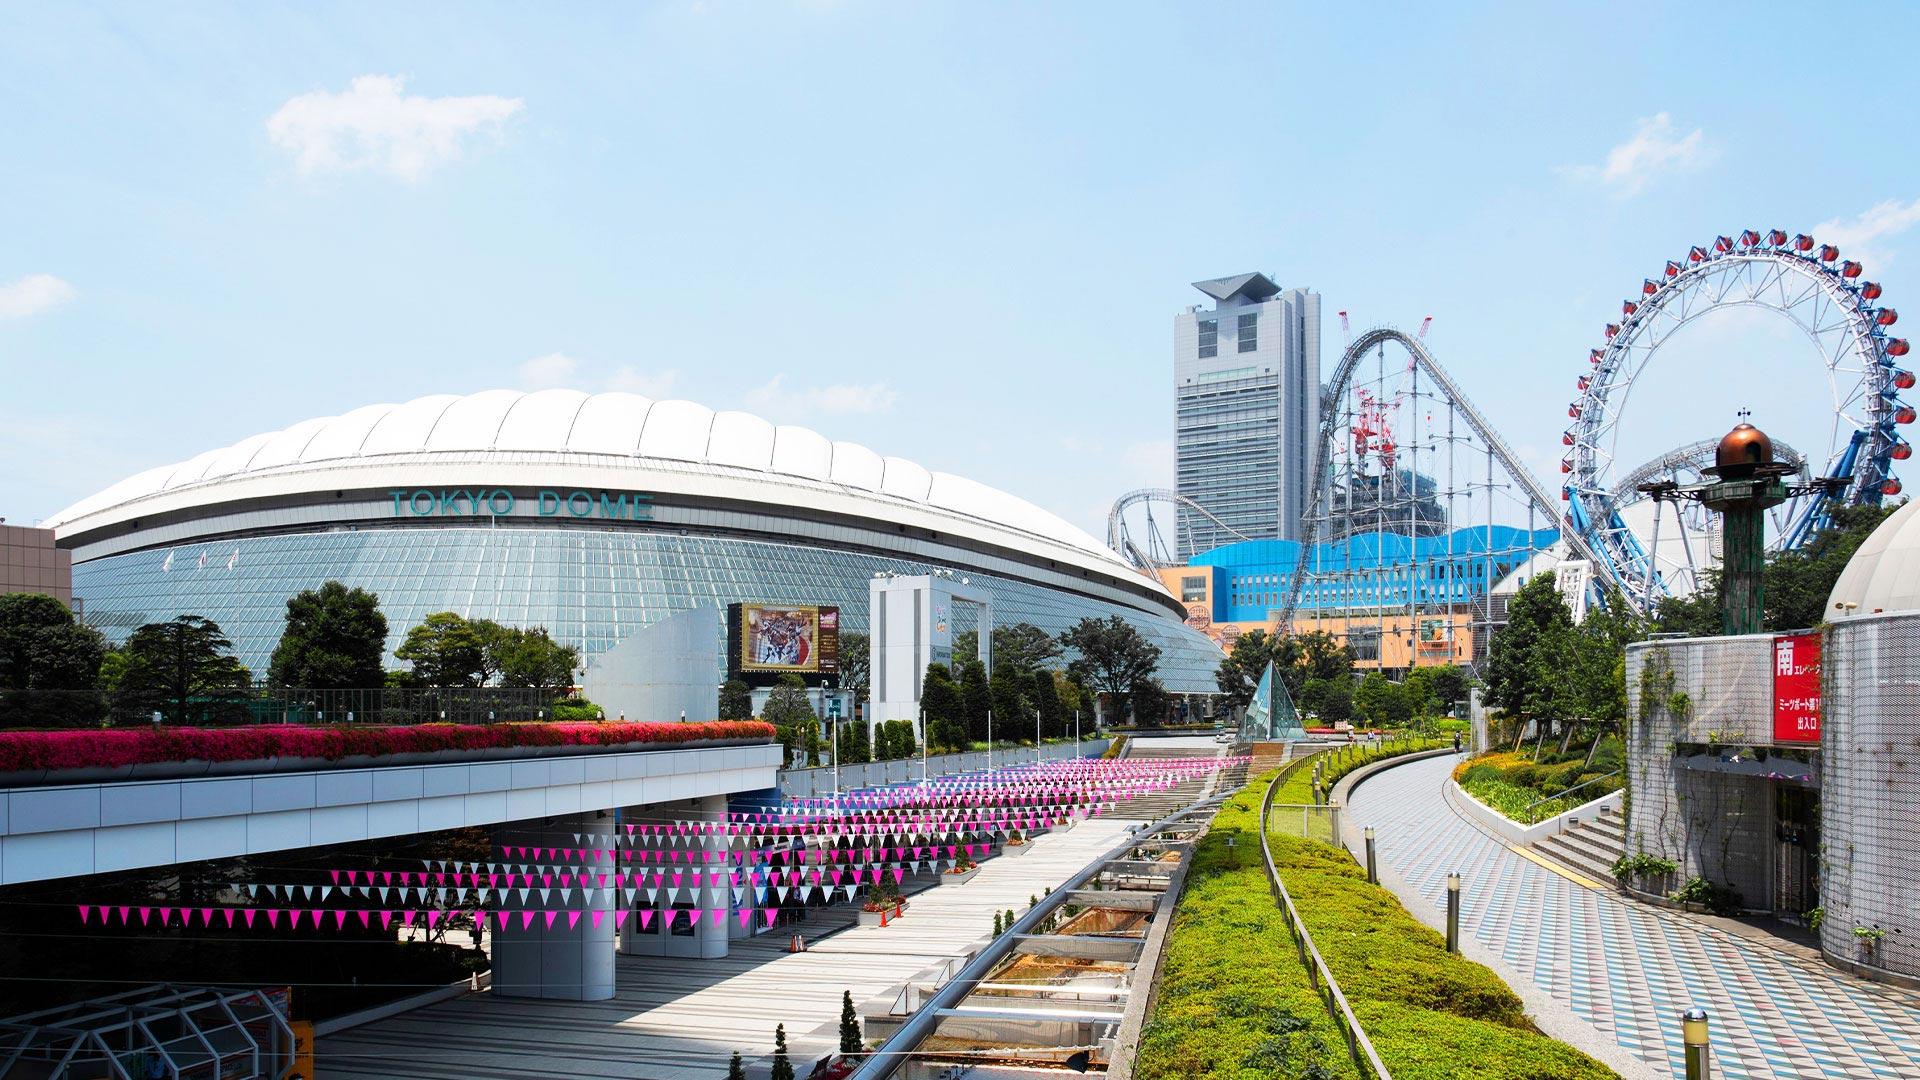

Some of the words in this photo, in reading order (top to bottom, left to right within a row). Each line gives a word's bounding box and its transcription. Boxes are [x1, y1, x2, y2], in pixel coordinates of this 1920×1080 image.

[388, 488, 514, 516] TOKYO
[538, 490, 655, 520] DOME
[1797, 716, 1817, 731] 出入口
